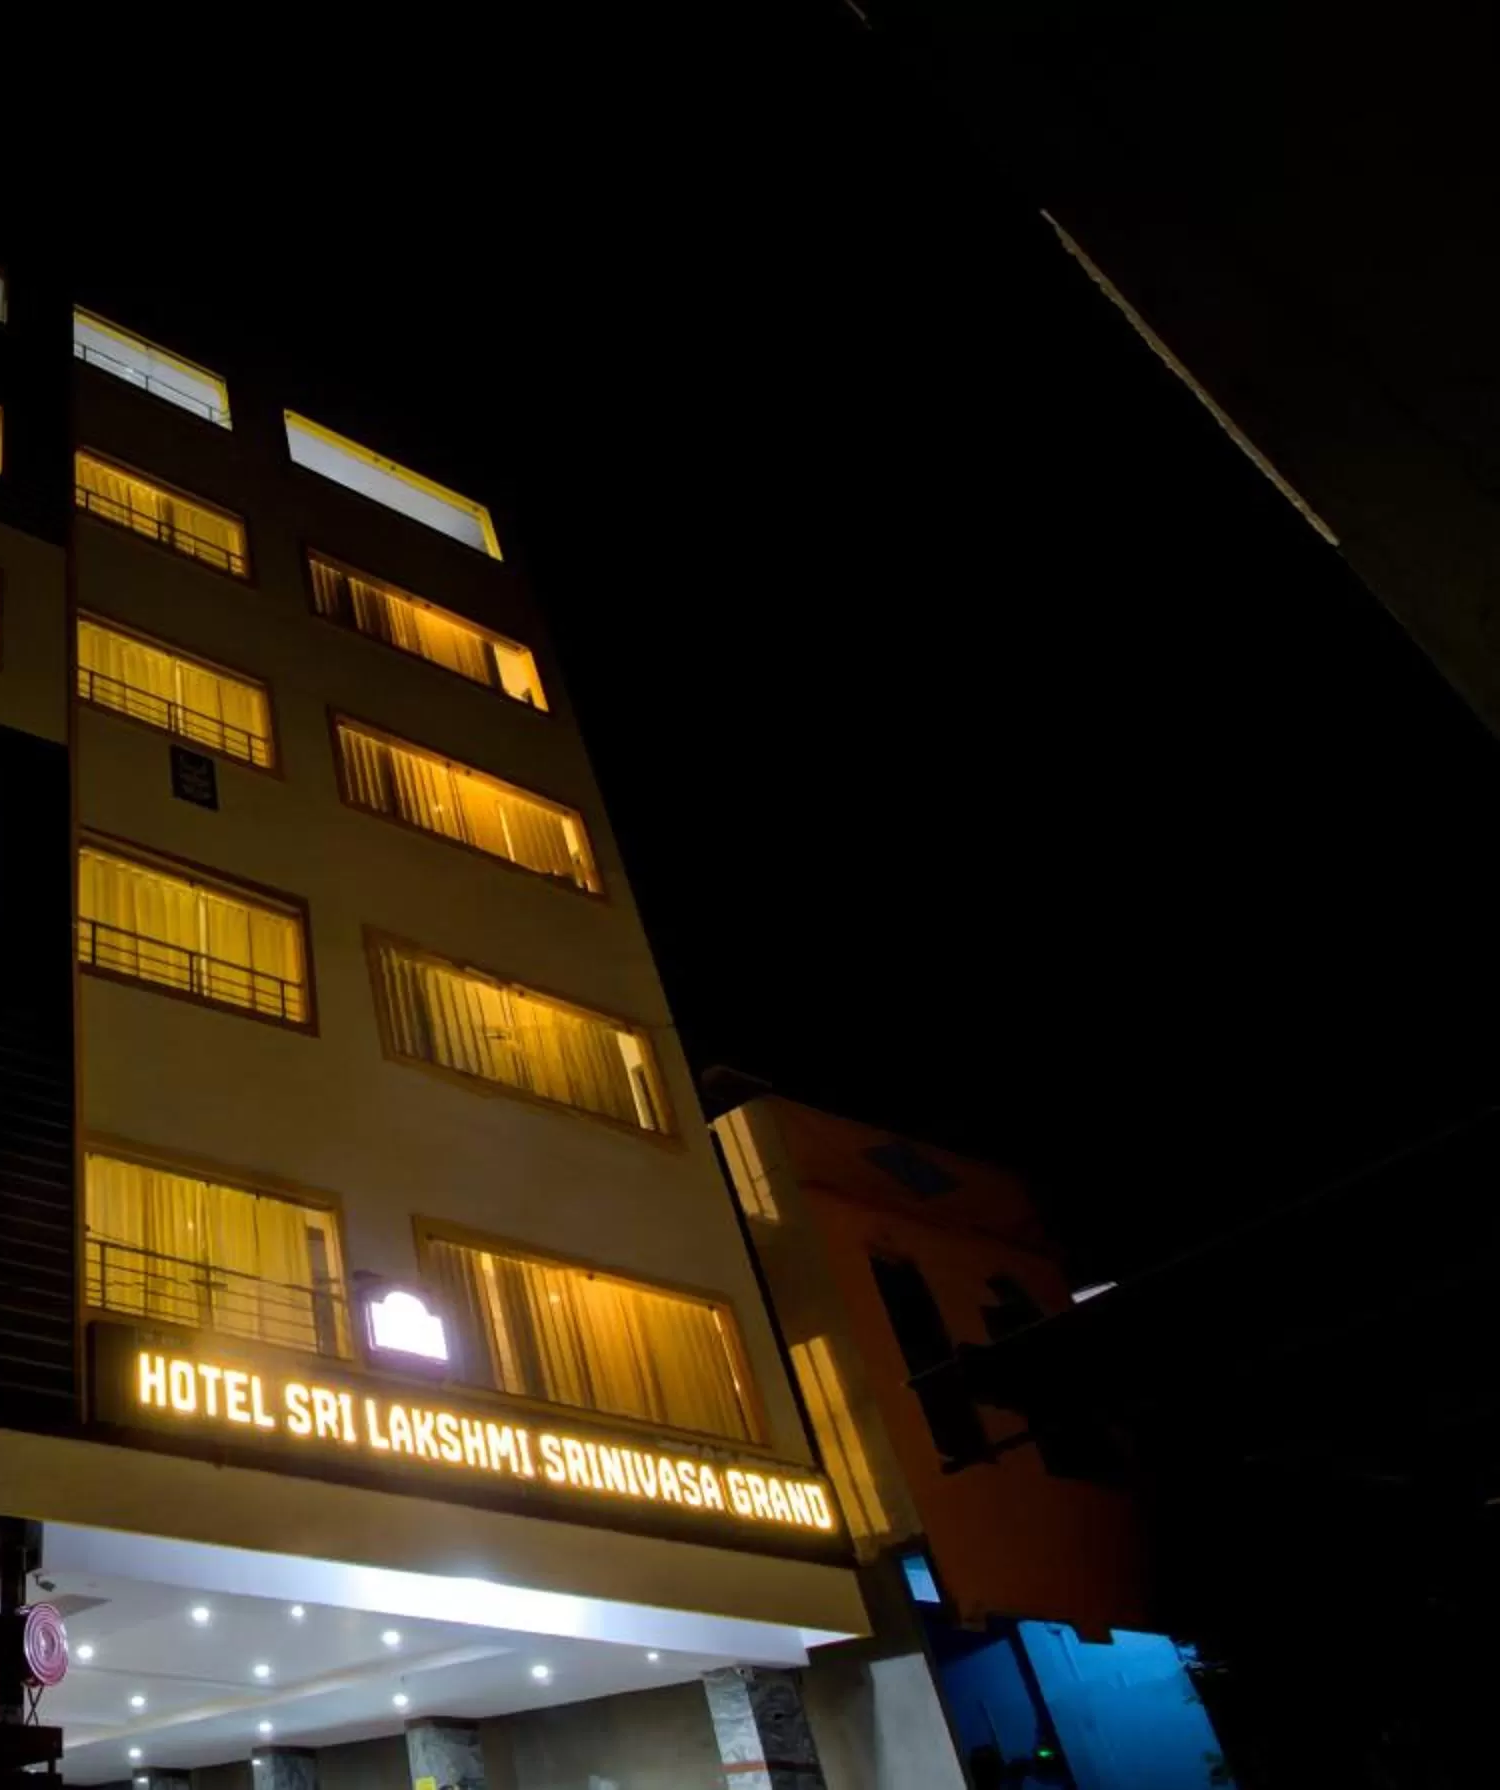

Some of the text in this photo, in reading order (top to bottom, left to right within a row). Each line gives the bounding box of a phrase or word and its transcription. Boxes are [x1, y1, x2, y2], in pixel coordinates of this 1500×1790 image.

[138, 1353, 832, 1529] HOTEL SRI LAKSHMI SRINIVASA GRAND
